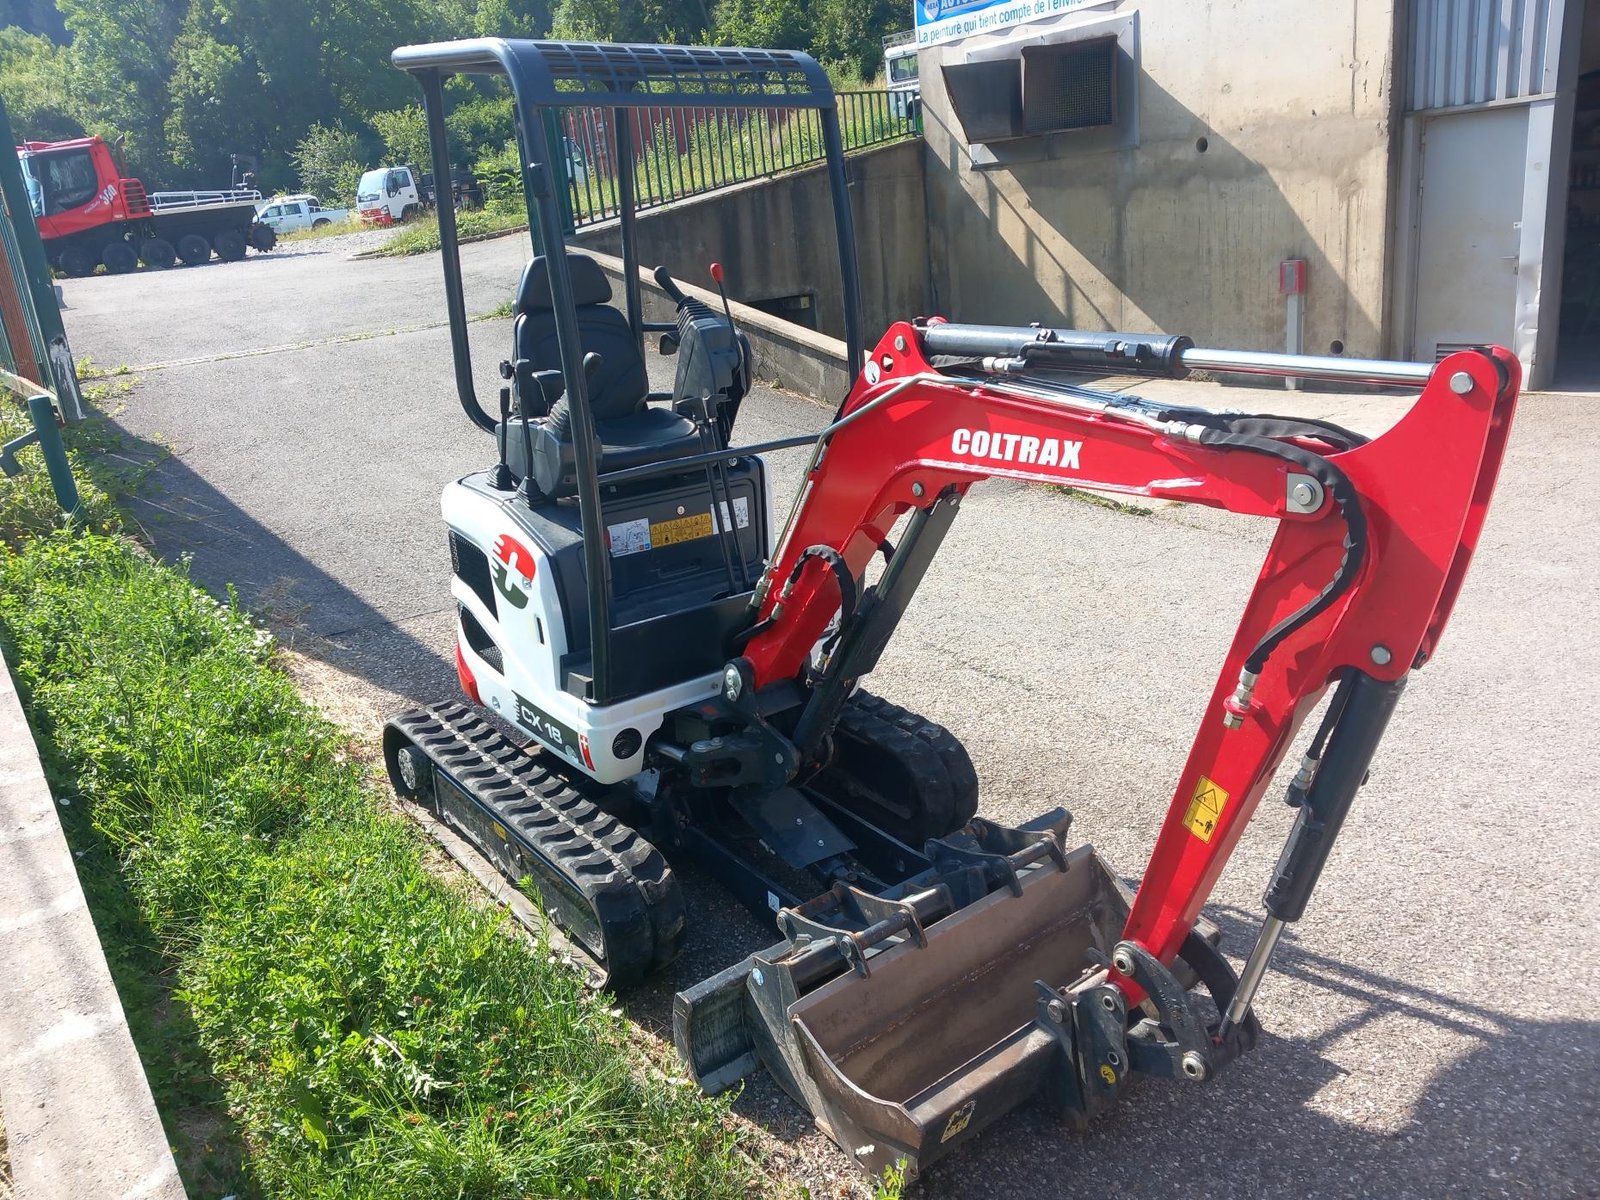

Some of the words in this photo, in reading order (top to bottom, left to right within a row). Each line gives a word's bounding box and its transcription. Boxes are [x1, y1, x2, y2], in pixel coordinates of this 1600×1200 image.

[918, 29, 928, 43] La
[930, 21, 962, 44] peinture
[964, 15, 977, 35] qui
[979, 10, 998, 29] tient
[999, 3, 1031, 23] compte
[1034, 0, 1045, 14] de
[951, 428, 1084, 470] COLTRAX
[521, 705, 544, 733] CX
[544, 722, 563, 745] 18
